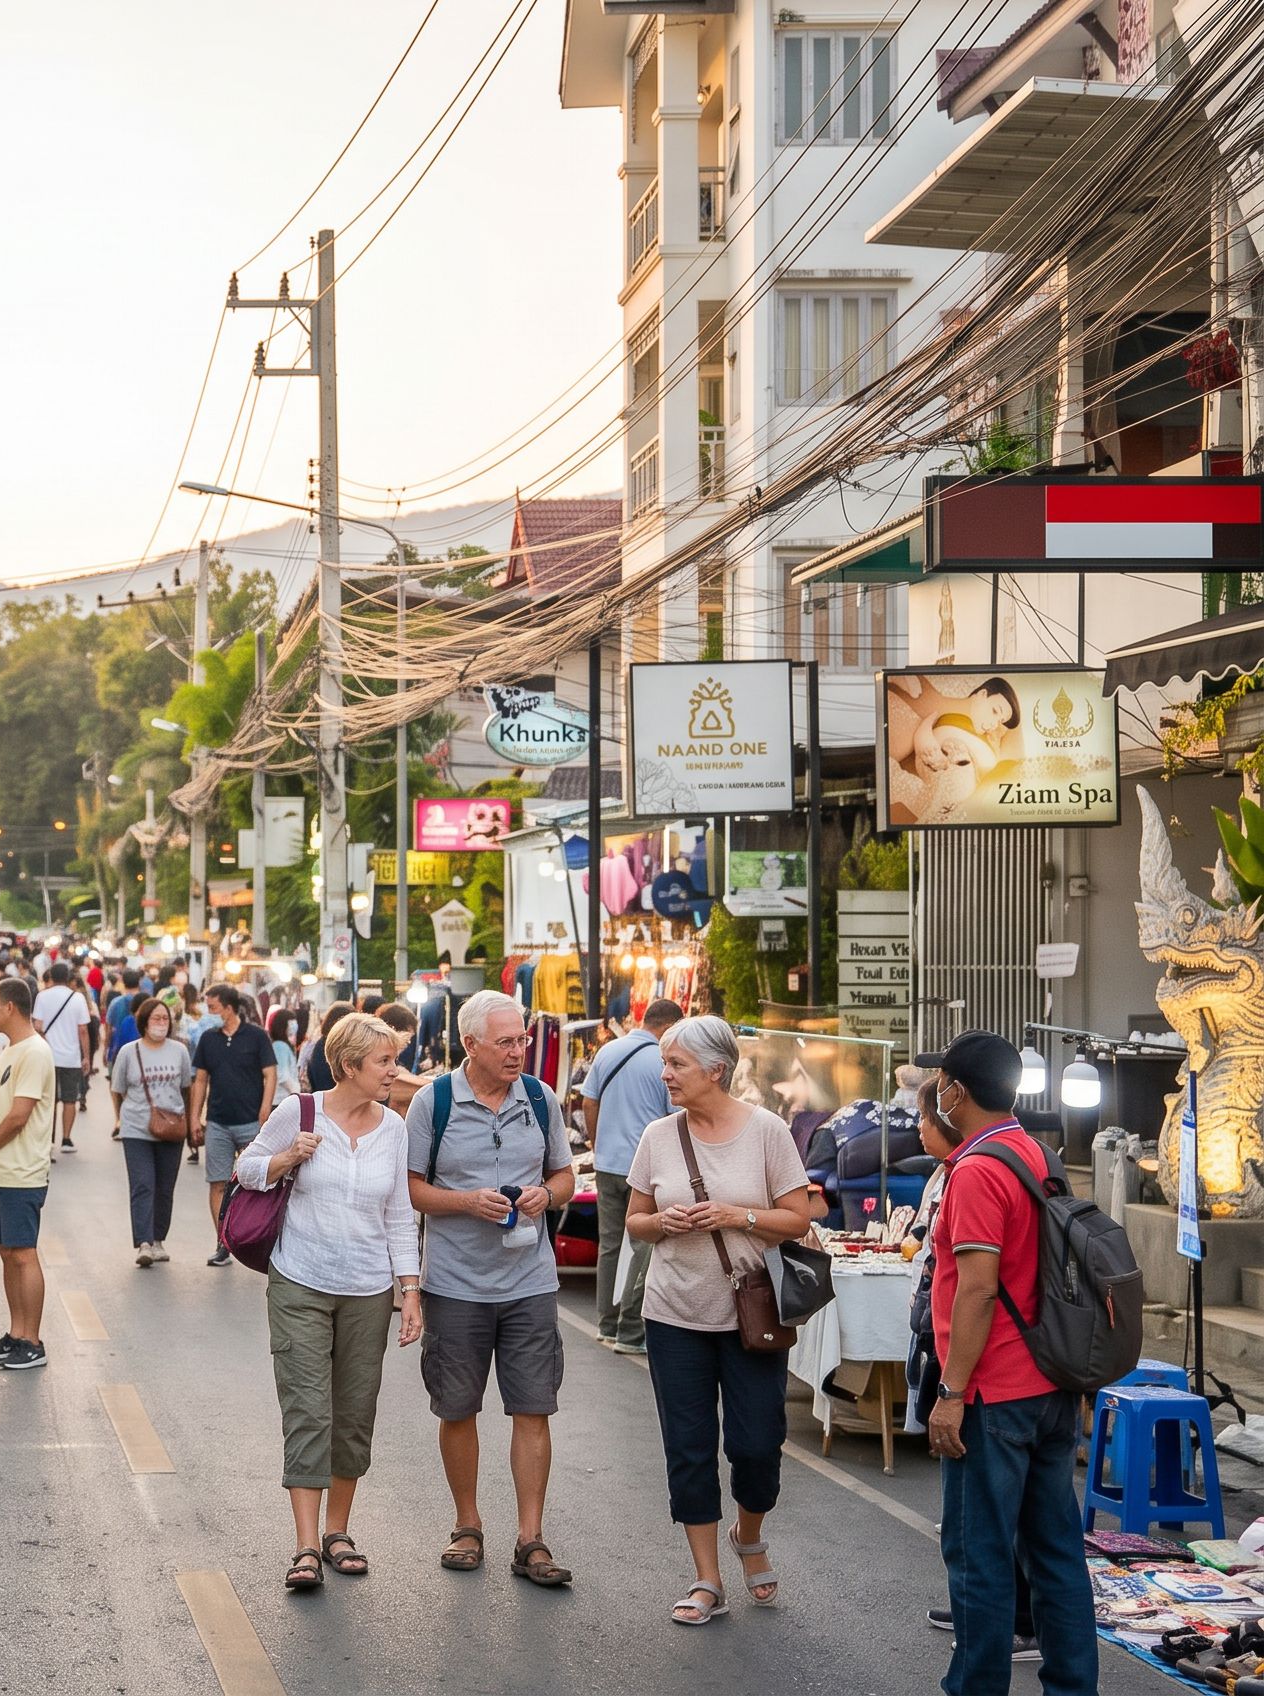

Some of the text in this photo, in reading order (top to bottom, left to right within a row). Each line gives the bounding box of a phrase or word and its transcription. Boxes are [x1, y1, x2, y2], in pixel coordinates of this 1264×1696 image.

[657, 742, 767, 757] NAAND ONE
[998, 783, 1113, 809] Ziam Spa
